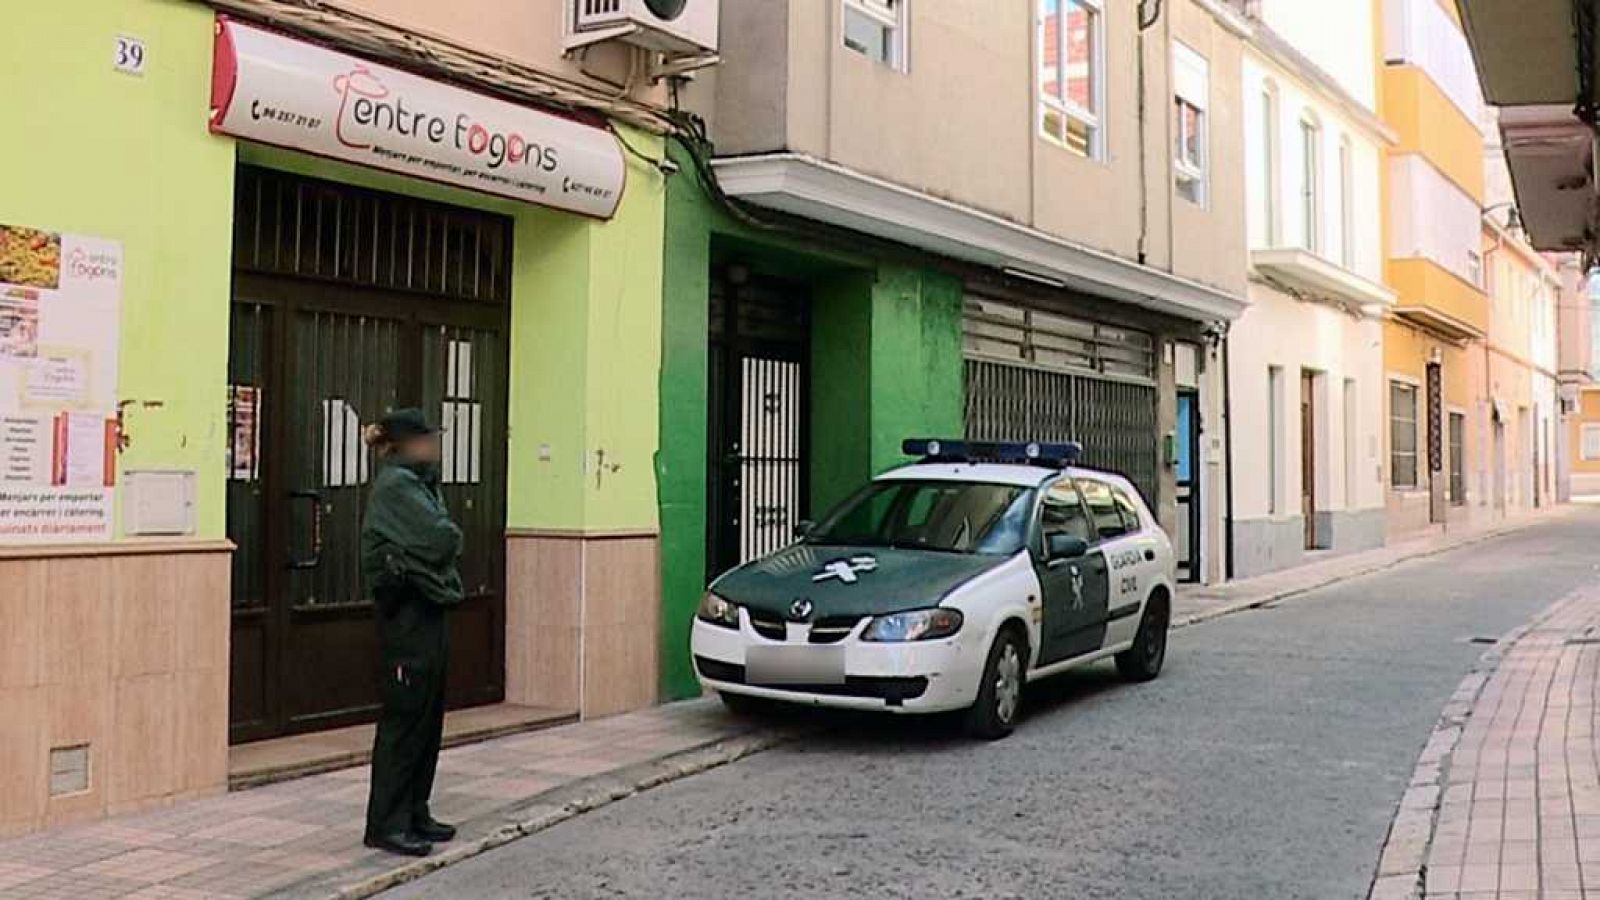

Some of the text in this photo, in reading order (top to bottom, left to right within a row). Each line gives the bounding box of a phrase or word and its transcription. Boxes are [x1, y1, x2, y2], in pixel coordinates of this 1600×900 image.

[117, 40, 143, 68] 39
[353, 97, 558, 171] entre fogons
[407, 155, 423, 163] per
[40, 494, 56, 503] per
[1109, 549, 1143, 571] GUARDIA
